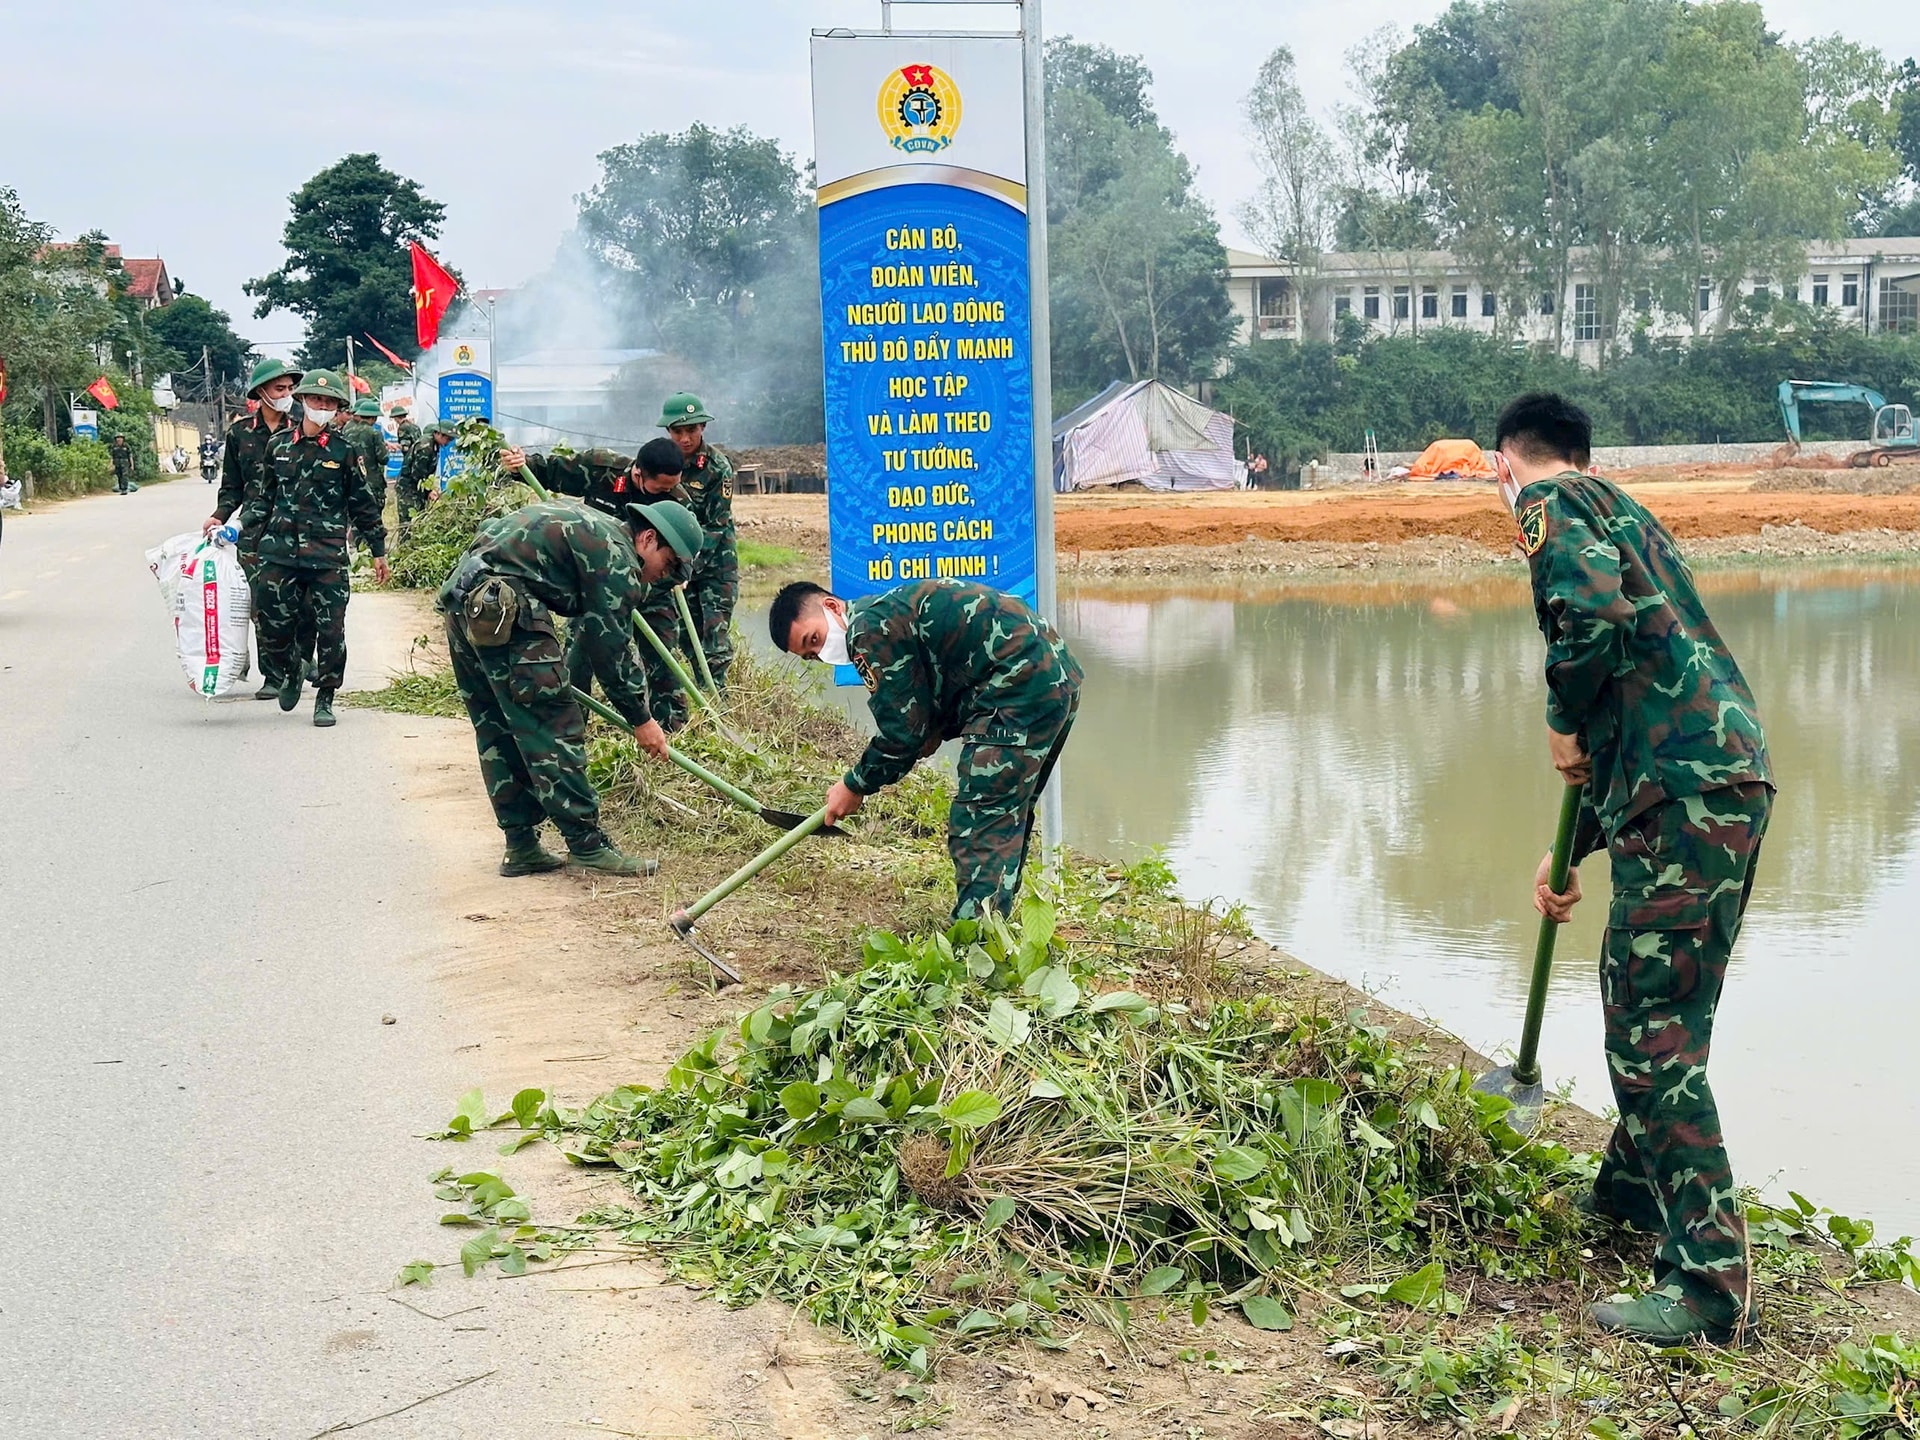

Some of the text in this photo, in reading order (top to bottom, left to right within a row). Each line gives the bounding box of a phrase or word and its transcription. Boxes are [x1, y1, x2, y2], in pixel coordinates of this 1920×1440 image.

[886, 224, 963, 253] CÁN BỘ,
[871, 261, 979, 288] ĐOÀN VIÊN,
[847, 297, 1005, 327] NGƯỜI LAO ĐỘNG
[840, 331, 1014, 363] THỦ ĐÔ ĐẨY MẠNH
[889, 371, 968, 402] HỌC TẬP
[867, 409, 991, 436] VÀ LÀM THEO
[882, 442, 979, 471] TƯ TƯỞNG,
[887, 480, 975, 512] ĐẠO ĐỨC,
[872, 516, 993, 544] PHONG CÁCH
[868, 552, 999, 580] HỒ CHÍ MINH !
